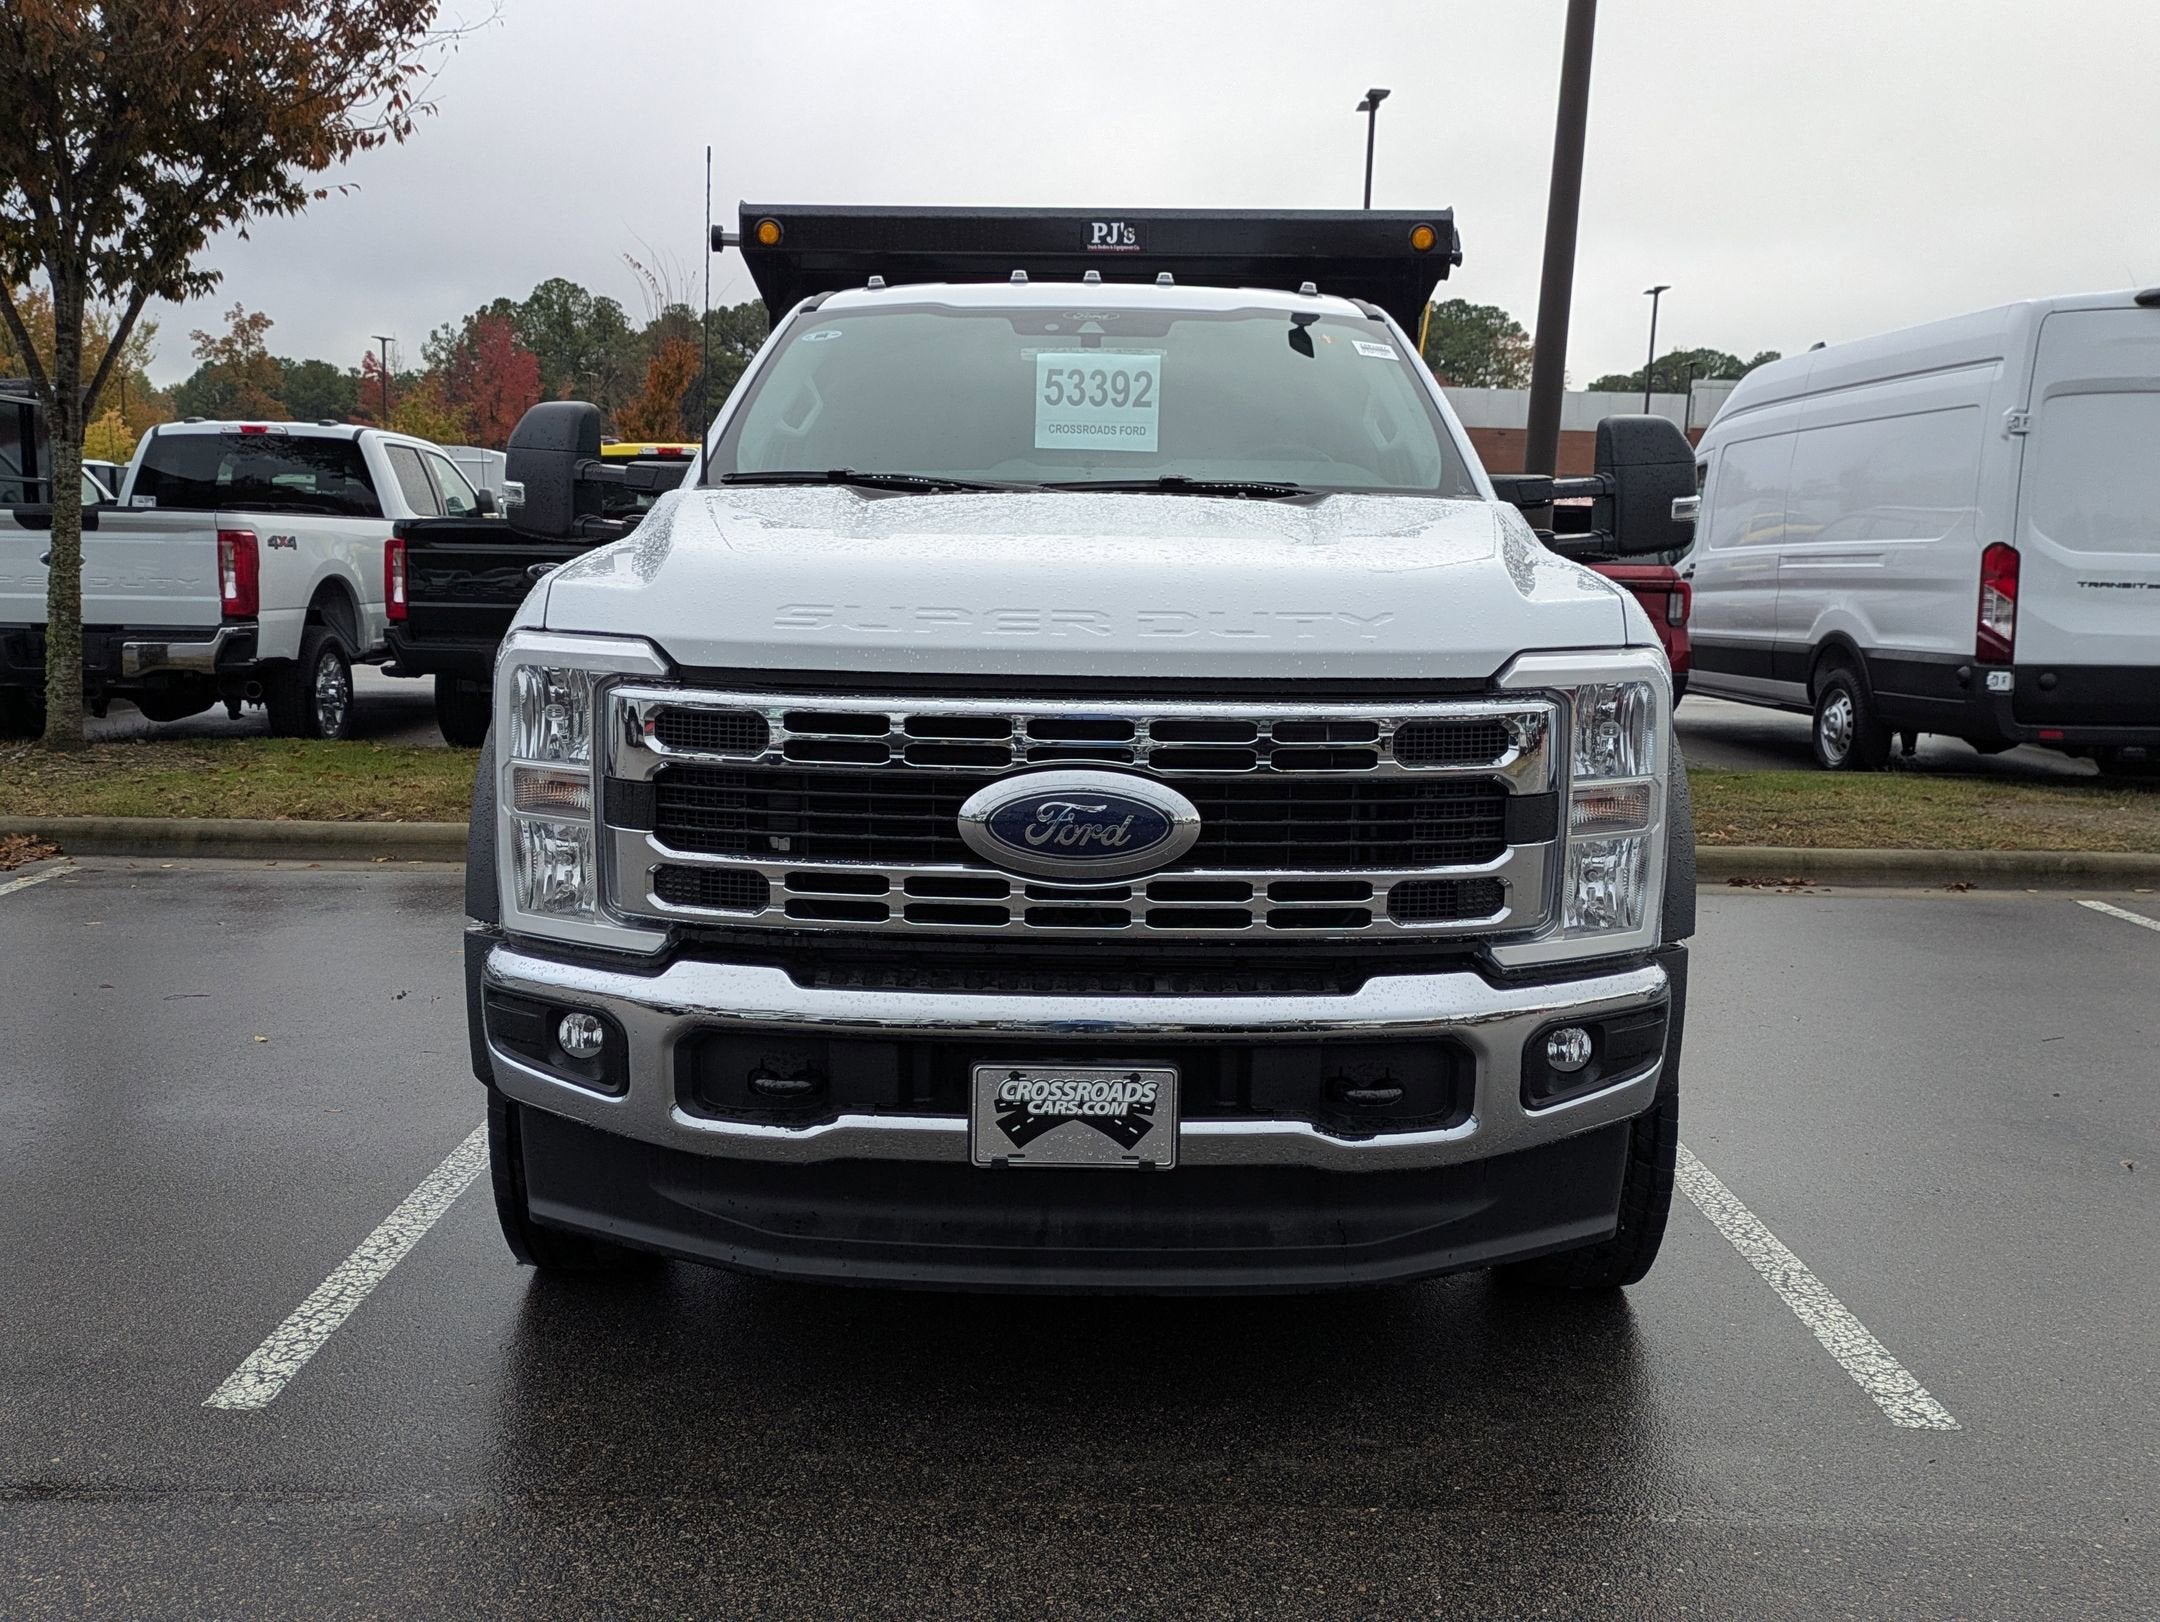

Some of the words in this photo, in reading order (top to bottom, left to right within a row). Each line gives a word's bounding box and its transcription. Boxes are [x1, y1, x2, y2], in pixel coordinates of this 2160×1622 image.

[1091, 222, 1136, 244] PJ's
[1044, 368, 1153, 408] 53392
[1048, 424, 1117, 435] CROSSROADS
[1119, 426, 1147, 436] FORD
[2077, 581, 2146, 589] TRANSIT
[772, 603, 1112, 637] SUPER
[1136, 610, 1395, 638] DUTY
[1024, 801, 1134, 847] Ford
[1000, 1079, 1158, 1103] CROSSROADS
[1027, 1100, 1129, 1116] CARS.COM
